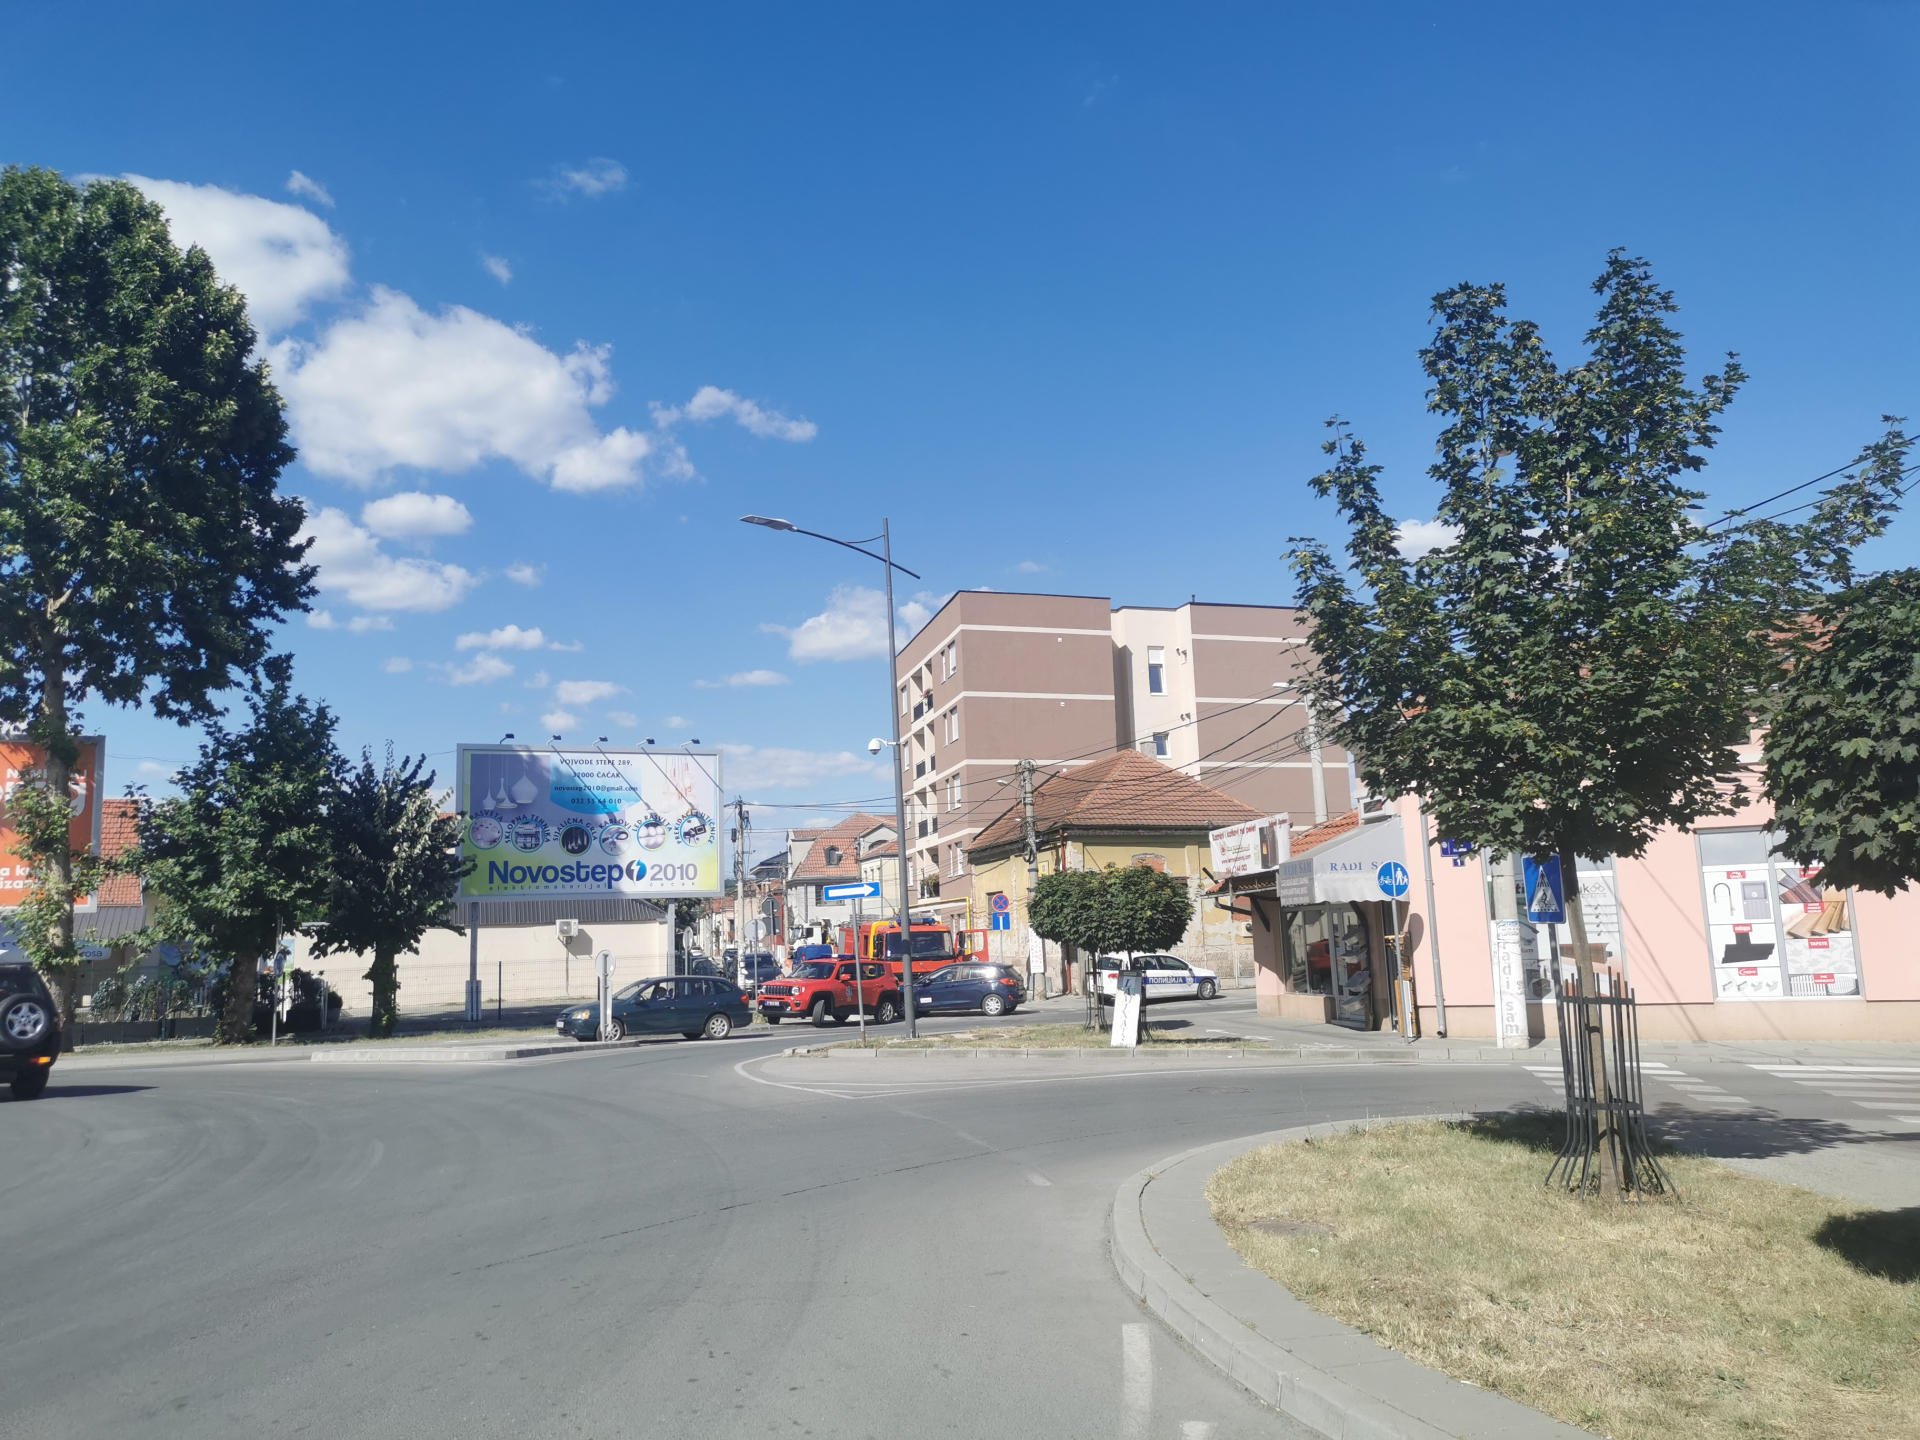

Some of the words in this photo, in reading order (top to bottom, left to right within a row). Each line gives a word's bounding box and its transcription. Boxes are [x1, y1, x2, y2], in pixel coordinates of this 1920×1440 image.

[559, 758, 593, 766] VOJVODE
[617, 759, 633, 767] 289,
[572, 771, 595, 779] 32000
[596, 770, 621, 779] ČAČAK
[469, 809, 503, 823] RASVETA
[505, 814, 528, 844] SKLOPNA
[531, 813, 551, 843] TEHNIKA
[632, 819, 643, 832] LED
[643, 814, 673, 832] RASVETA
[553, 817, 584, 842] SIJALIČNA
[585, 822, 598, 842] GRLA
[1330, 861, 1363, 872] RADI
[488, 860, 624, 890] Novostep
[649, 863, 698, 881] 2010
[488, 881, 607, 891] elektromaterijal
[1149, 976, 1183, 985] ПОЛИЦИЈА
